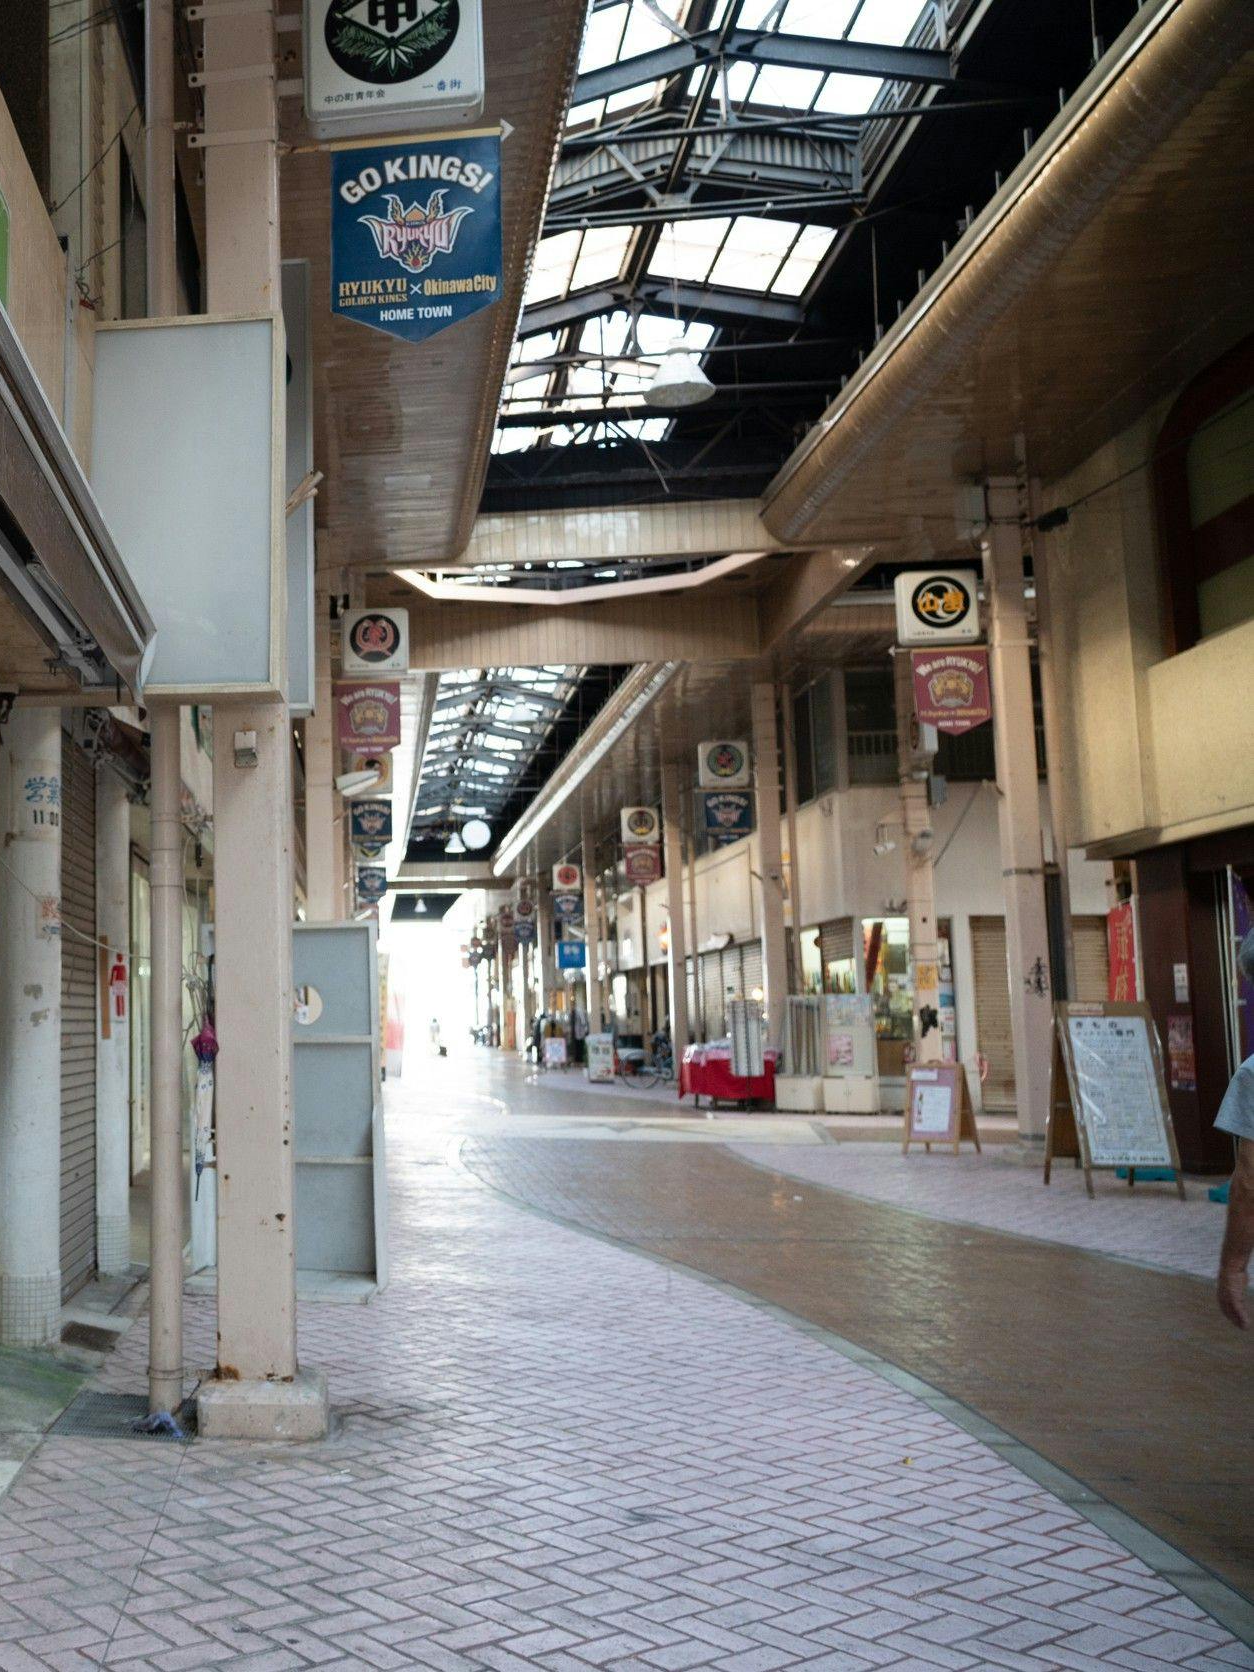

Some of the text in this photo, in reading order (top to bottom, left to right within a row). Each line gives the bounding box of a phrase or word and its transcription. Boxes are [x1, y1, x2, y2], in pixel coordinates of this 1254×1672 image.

[339, 277, 407, 297] RYUKYU
[339, 293, 408, 307] GOLDEN KINGS
[380, 305, 453, 322] HOME TOWN
